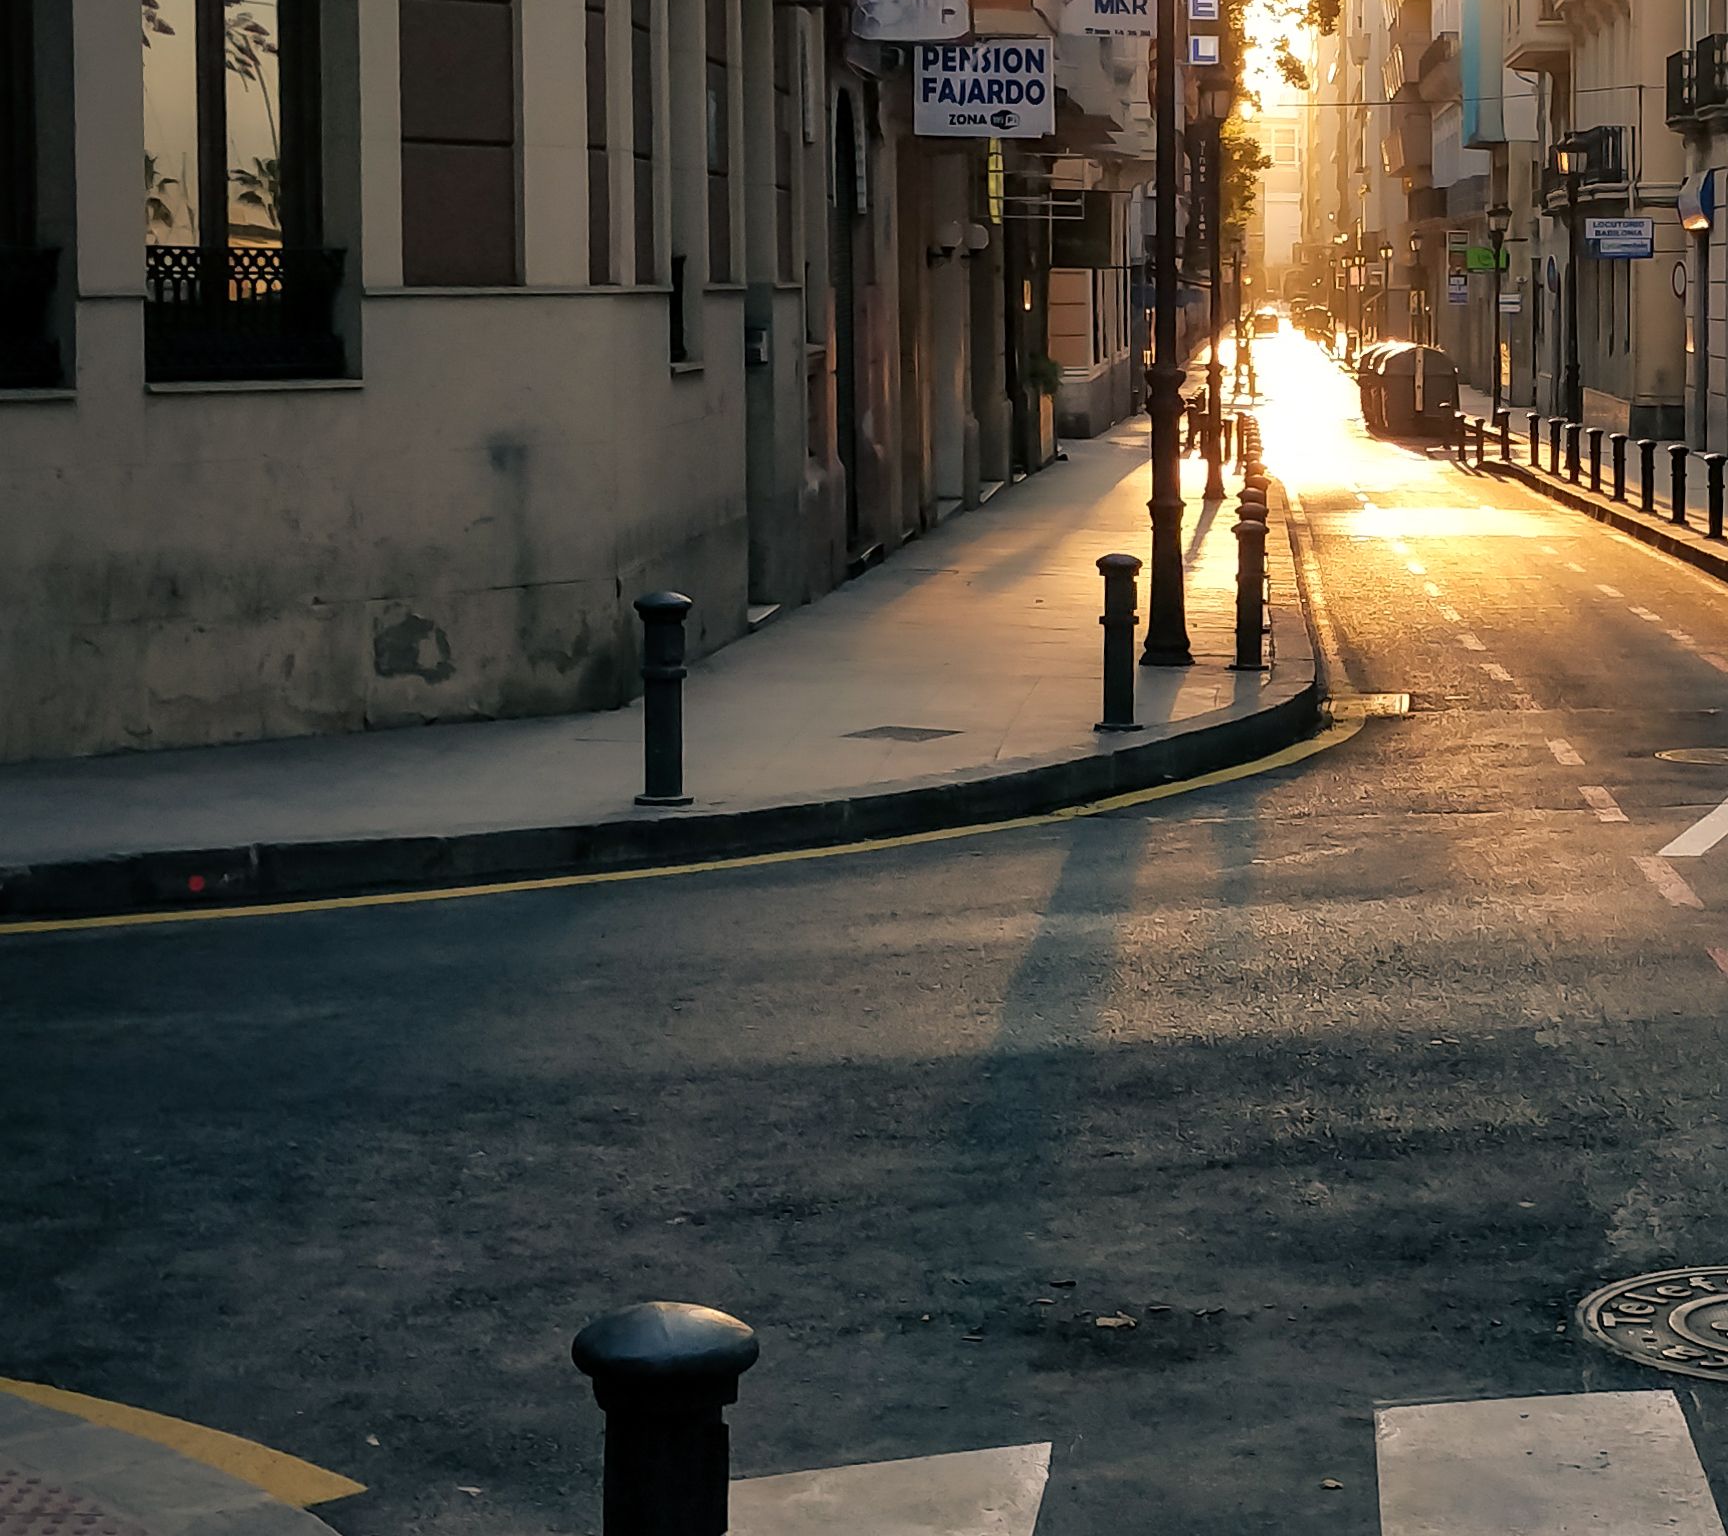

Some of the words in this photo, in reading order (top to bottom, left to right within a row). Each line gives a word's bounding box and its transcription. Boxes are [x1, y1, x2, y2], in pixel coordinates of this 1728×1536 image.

[922, 46, 1045, 74] PENSION
[922, 78, 1045, 106] FAJARDO
[949, 114, 987, 126] ZONA
